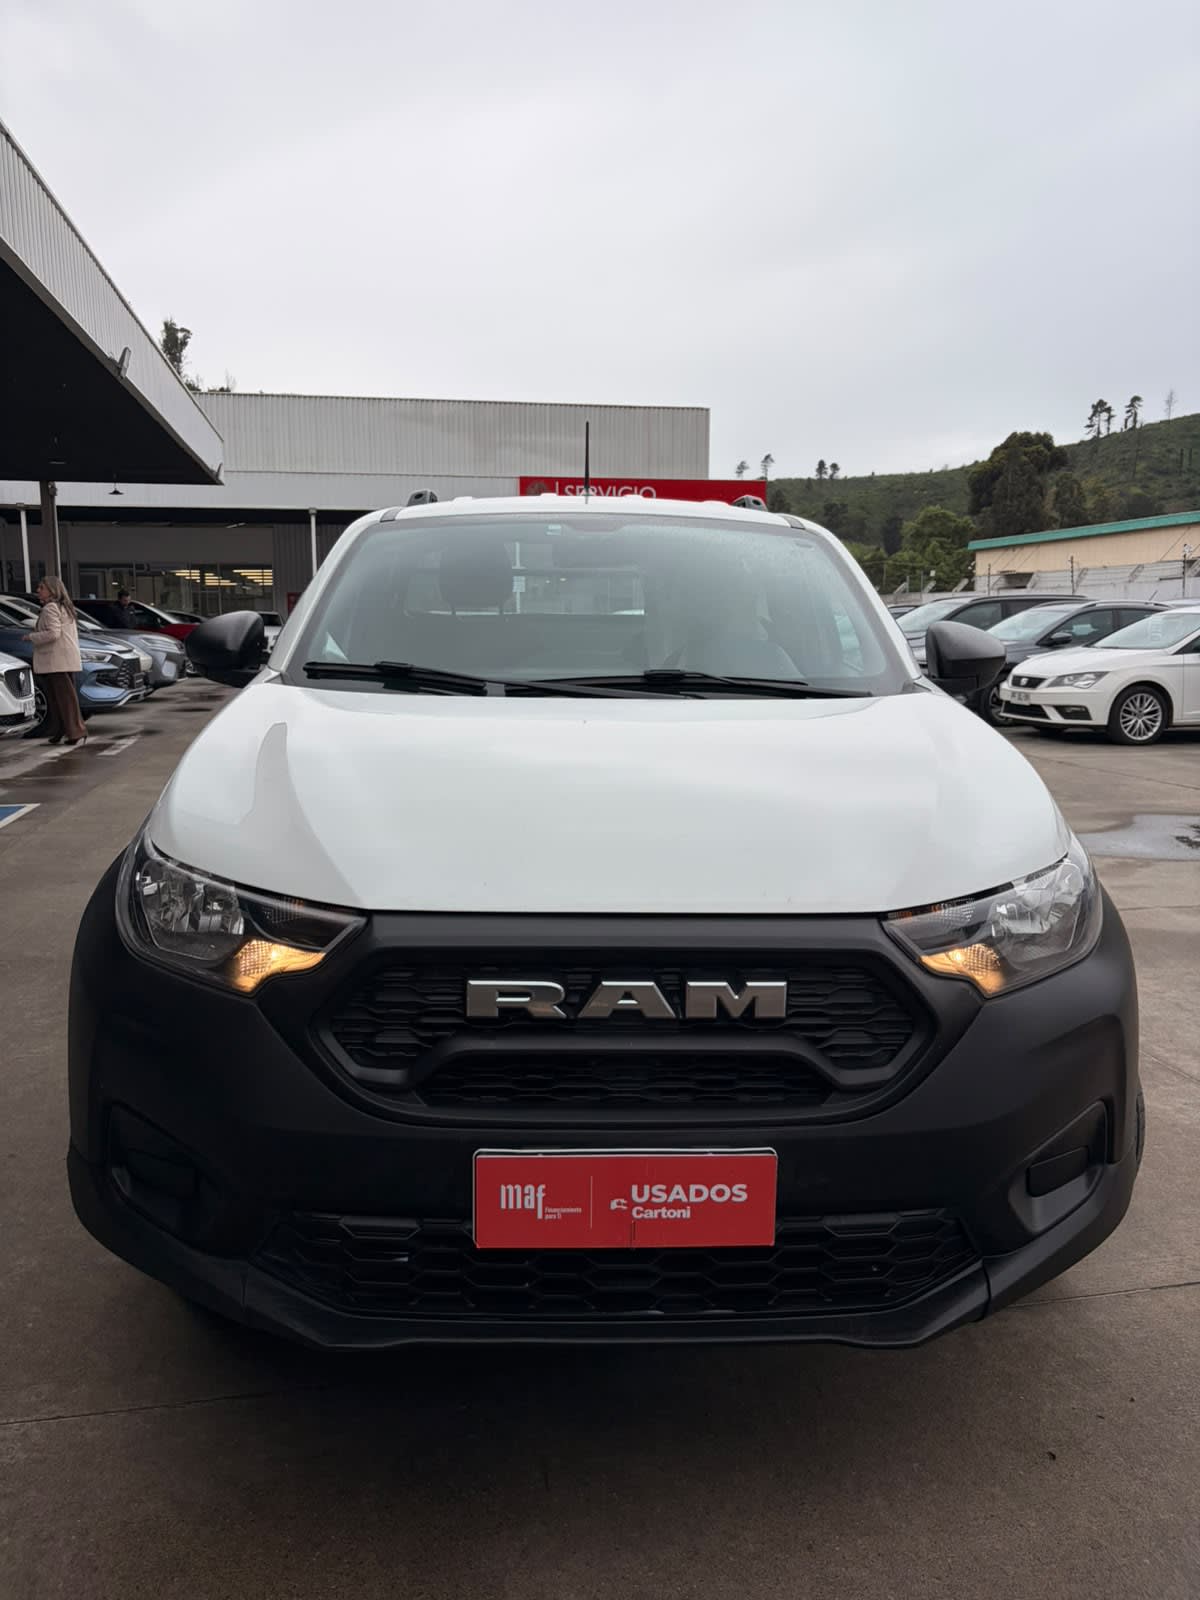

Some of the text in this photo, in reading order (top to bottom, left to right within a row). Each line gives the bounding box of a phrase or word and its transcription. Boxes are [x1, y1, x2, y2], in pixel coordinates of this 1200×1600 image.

[465, 980, 787, 1018] RAM
[500, 1184, 546, 1219] maf
[631, 1184, 748, 1202] USADOS
[632, 1206, 691, 1219] Cartoni
